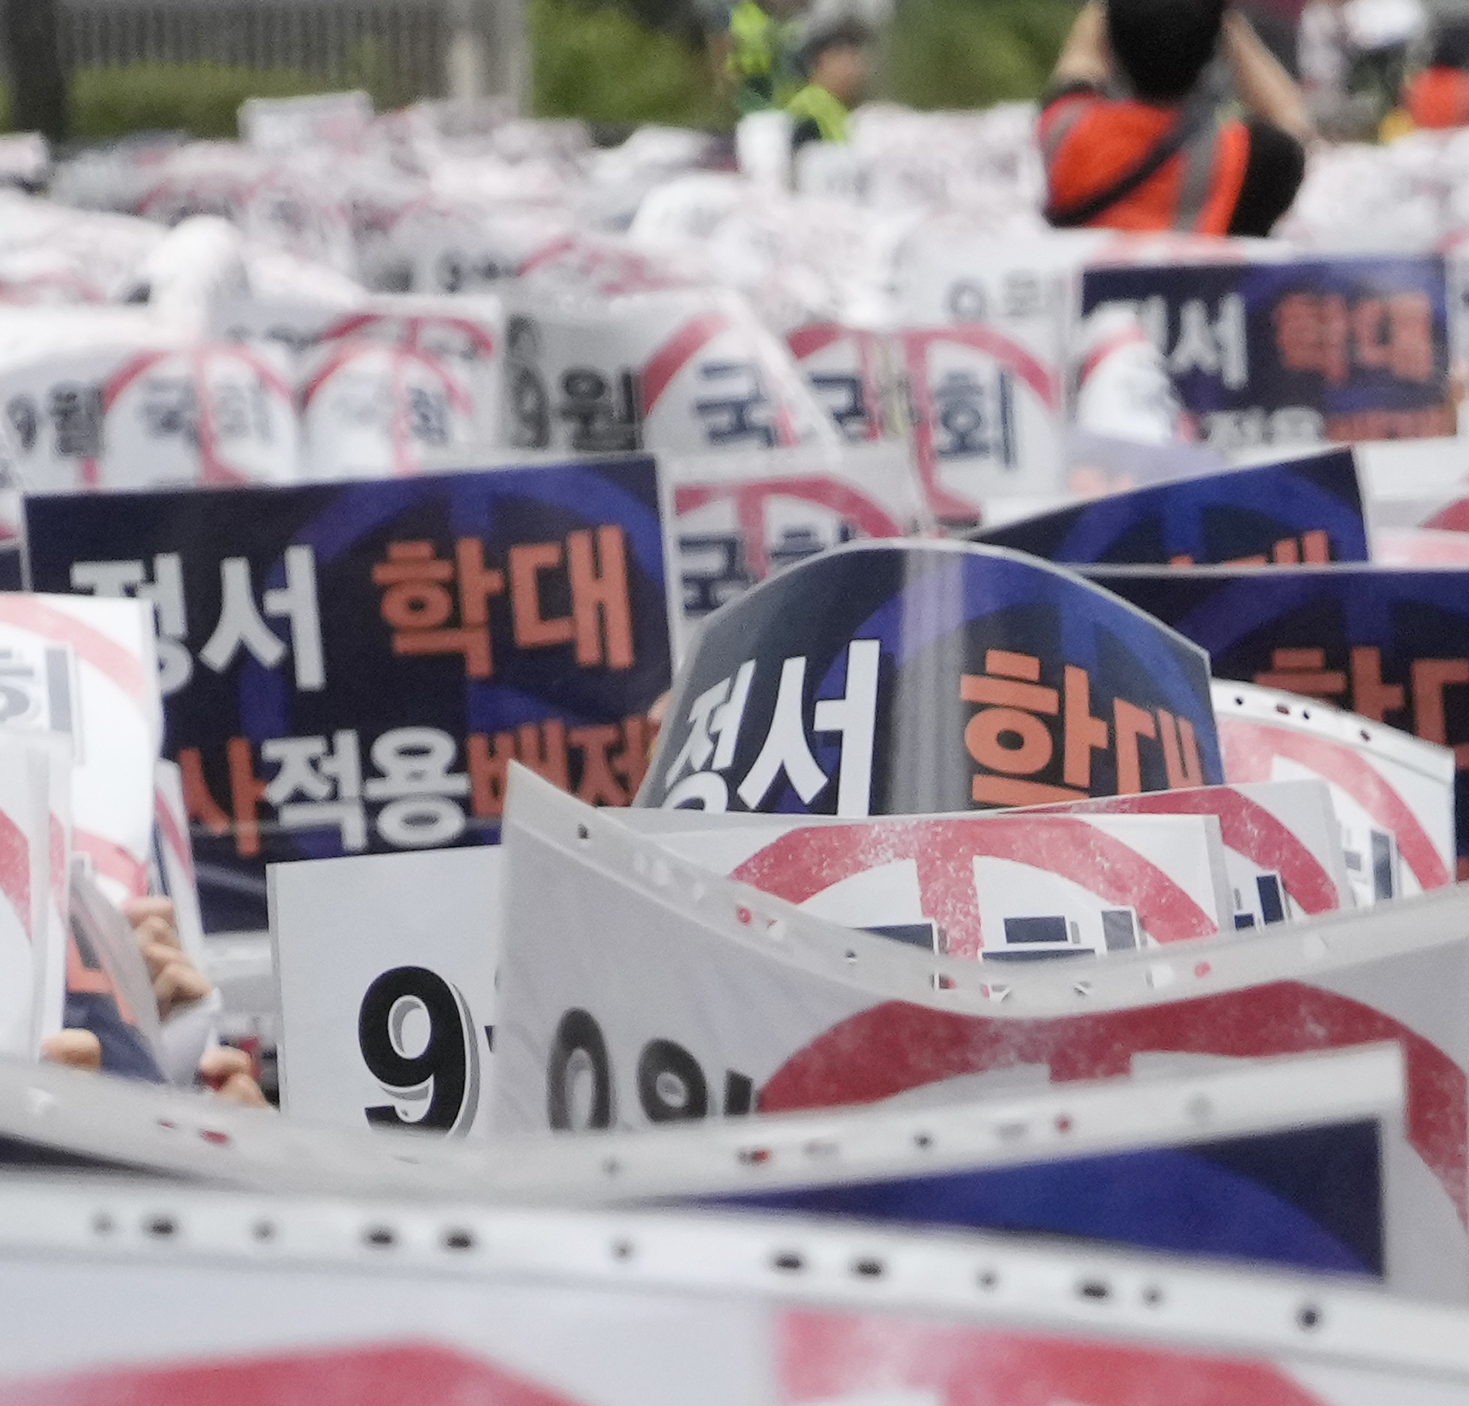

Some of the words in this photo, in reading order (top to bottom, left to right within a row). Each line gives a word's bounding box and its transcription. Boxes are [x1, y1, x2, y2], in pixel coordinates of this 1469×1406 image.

[694, 364, 780, 448] 국
[369, 525, 634, 679] 학대
[660, 639, 881, 818] 정서
[358, 965, 472, 1138] 9
